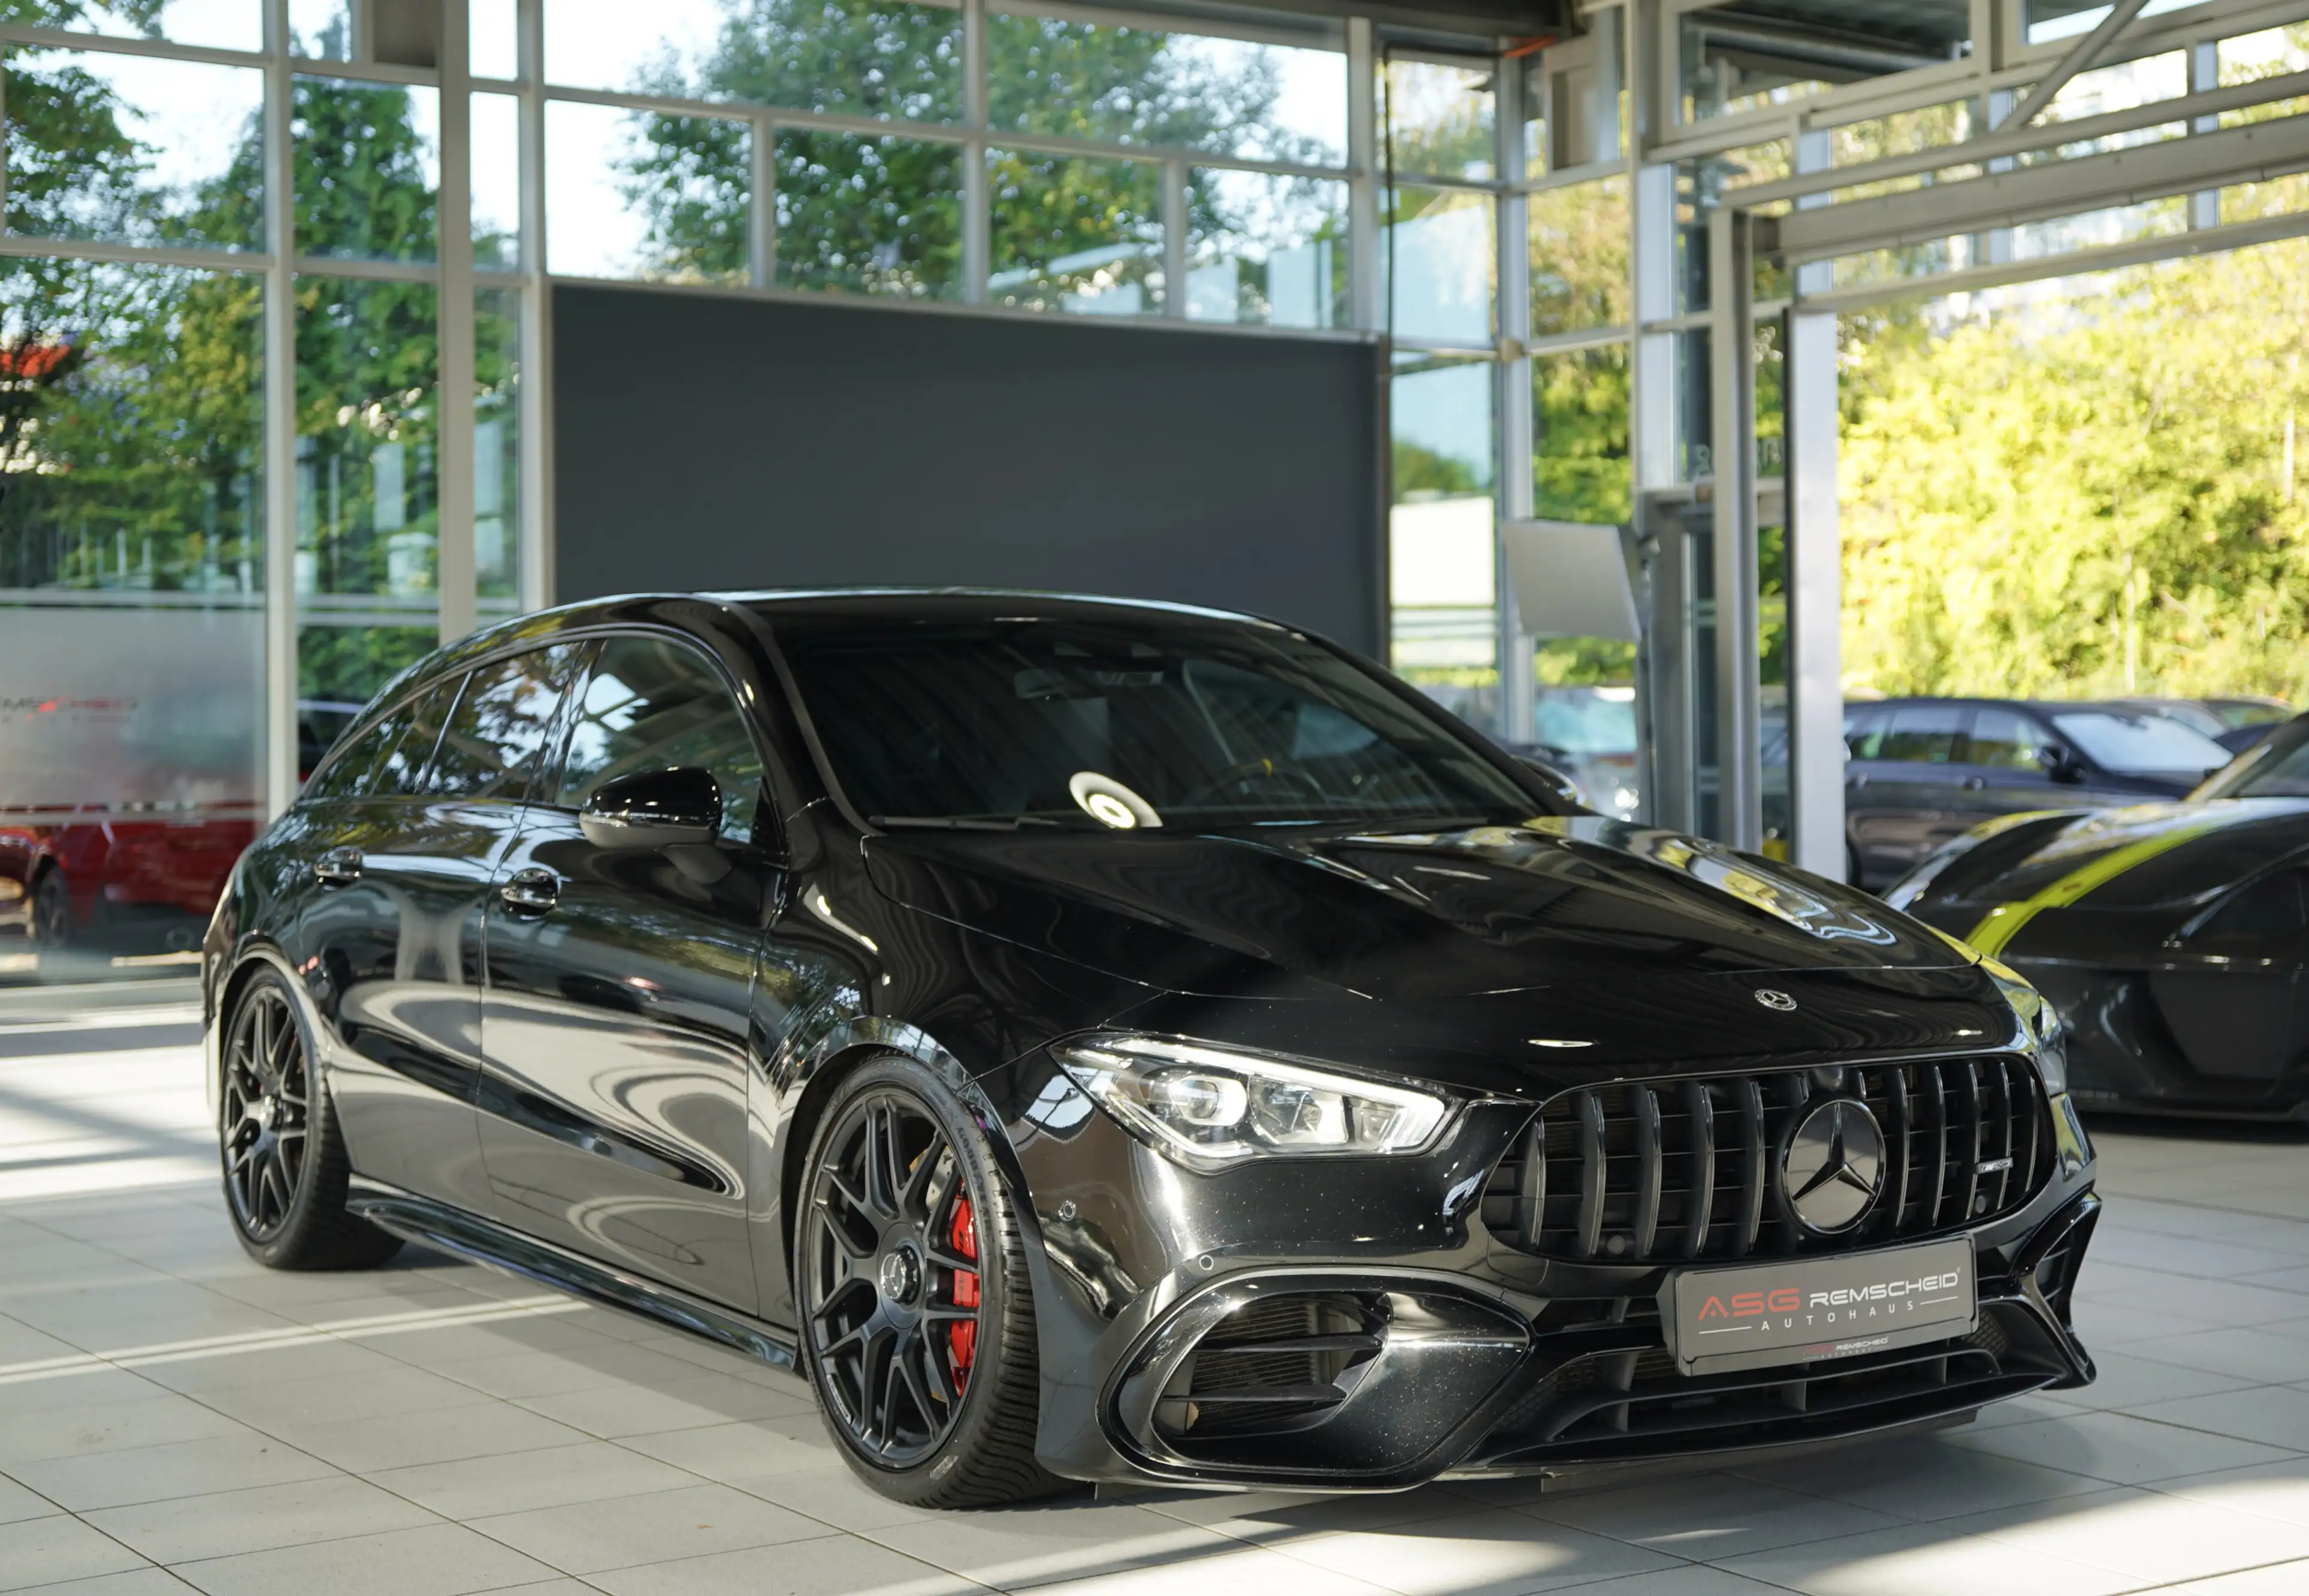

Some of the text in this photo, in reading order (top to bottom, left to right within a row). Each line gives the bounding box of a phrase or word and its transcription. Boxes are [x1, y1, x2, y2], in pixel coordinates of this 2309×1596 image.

[1698, 1272, 1958, 1321] ASG REMSCHEID
[1761, 1301, 1914, 1331] AUTOHAUS
